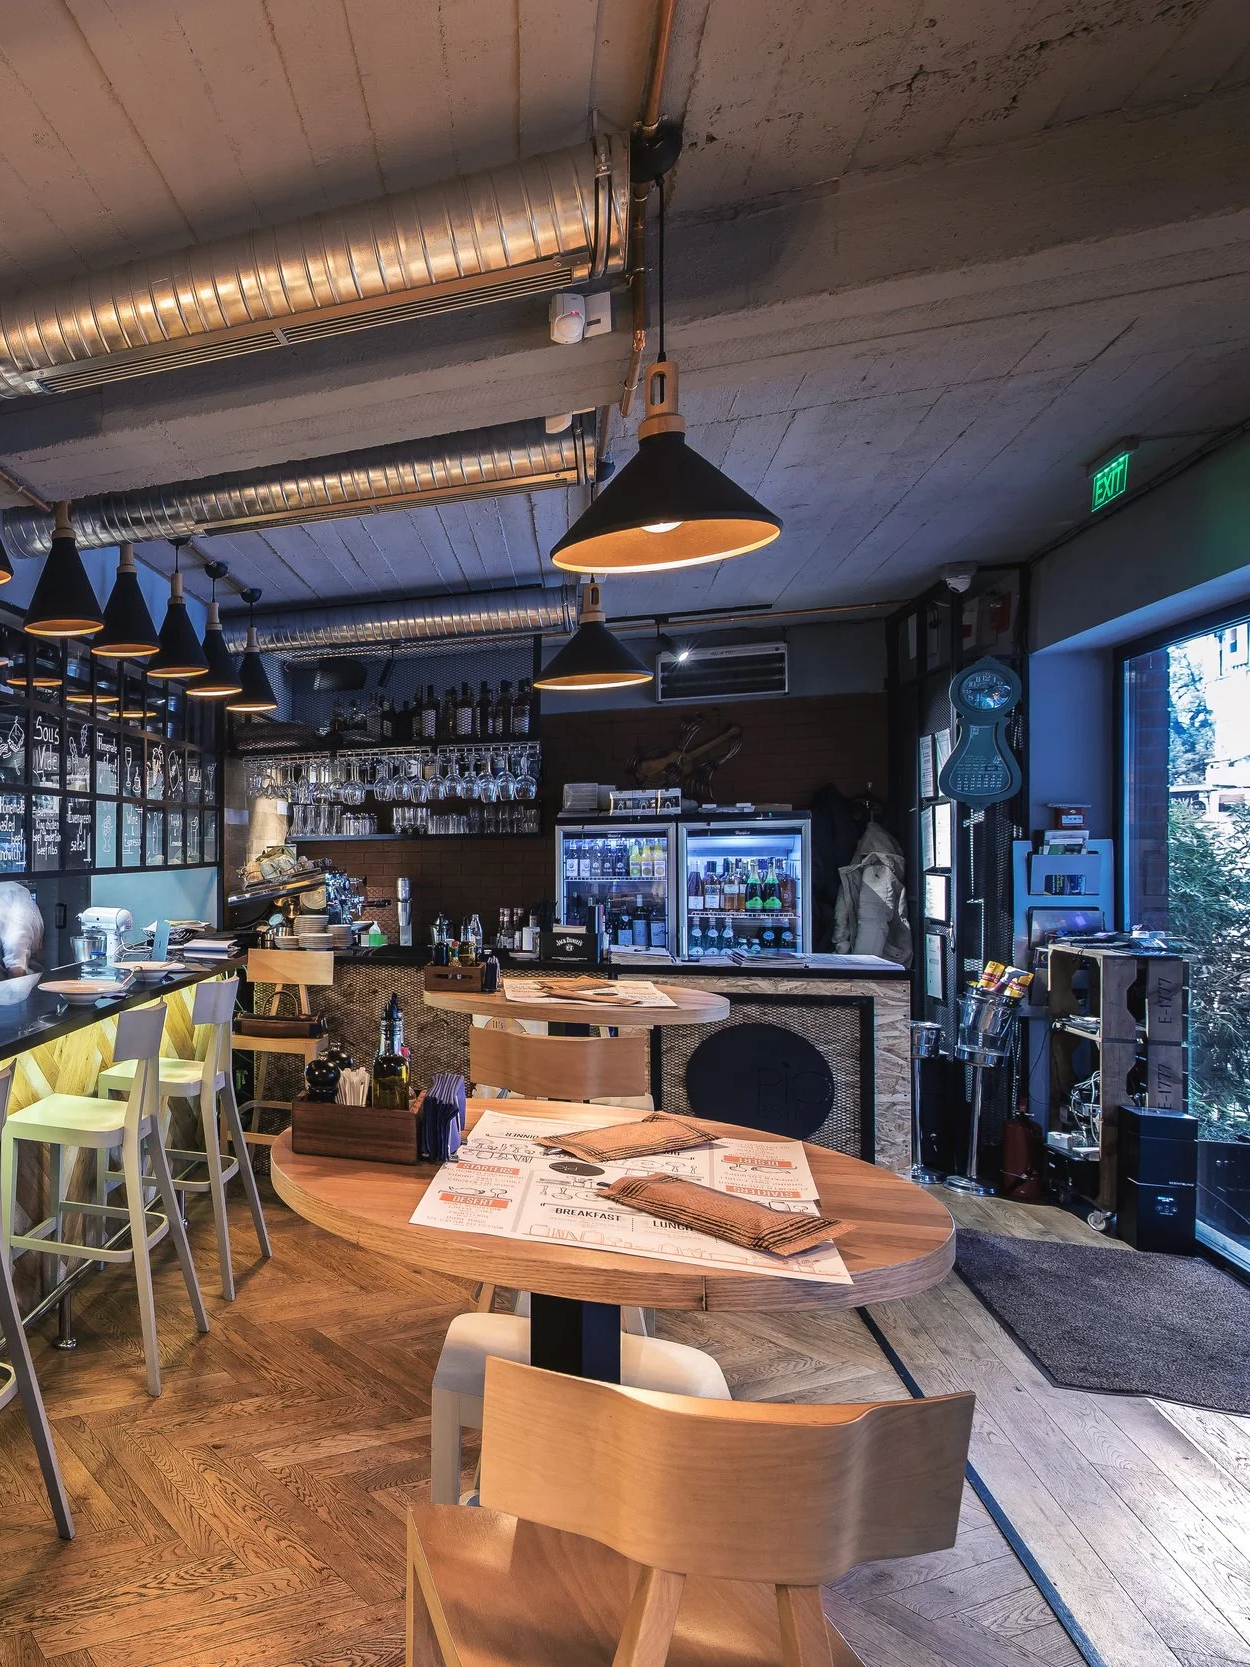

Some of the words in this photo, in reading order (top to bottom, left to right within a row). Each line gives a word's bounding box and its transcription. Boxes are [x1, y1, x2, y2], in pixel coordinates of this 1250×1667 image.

[1095, 463, 1124, 506] EXIT
[34, 716, 60, 744] Sous
[555, 938, 566, 947] JACK
[1157, 977, 1172, 1024] E-1777
[1157, 1063, 1172, 1110] E-1777
[462, 1162, 514, 1175] STARTERS
[452, 1195, 493, 1207] DESERT
[555, 1207, 622, 1222] BREAKFAST
